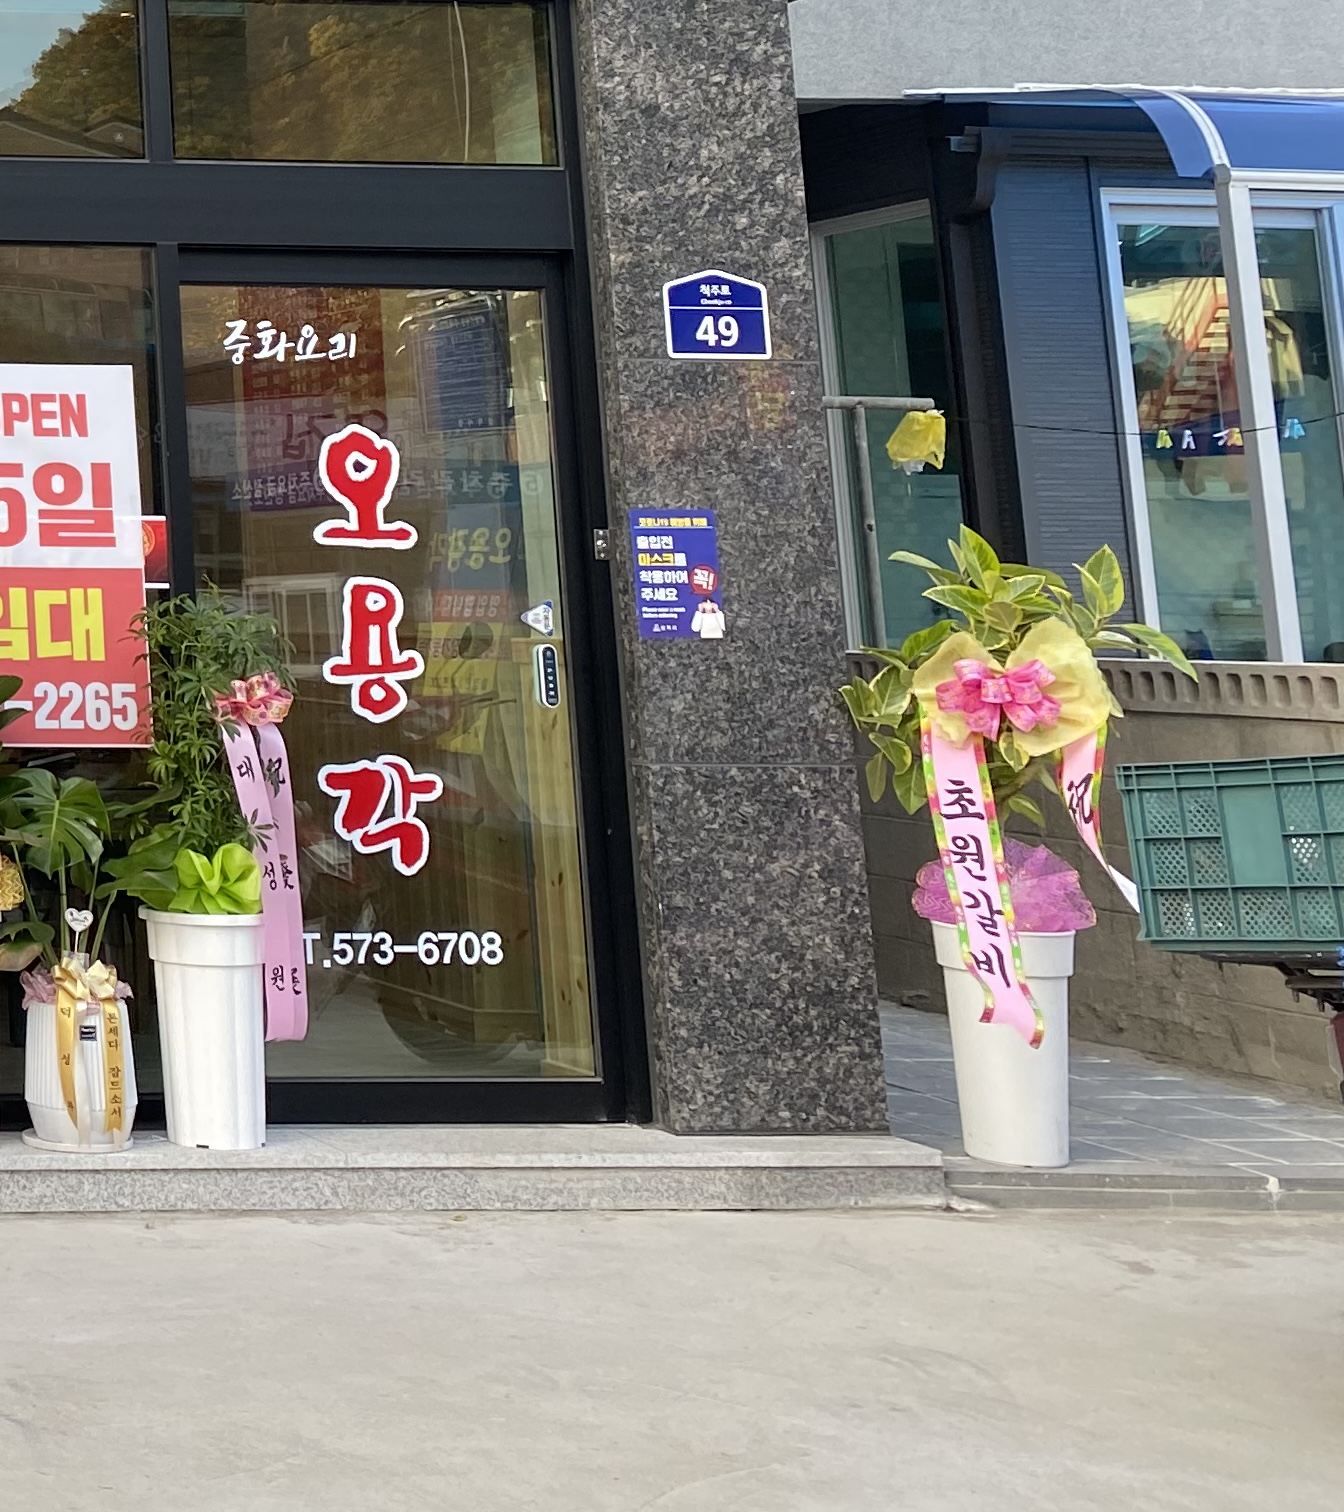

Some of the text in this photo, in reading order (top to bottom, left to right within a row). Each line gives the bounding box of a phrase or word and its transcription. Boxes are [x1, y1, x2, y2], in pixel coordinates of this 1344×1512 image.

[223, 319, 356, 364] 중화요리
[695, 315, 739, 347] 49
[313, 424, 444, 876] 오용각
[939, 779, 1010, 988] 초원갈비
[302, 930, 505, 968] T.573-6708
